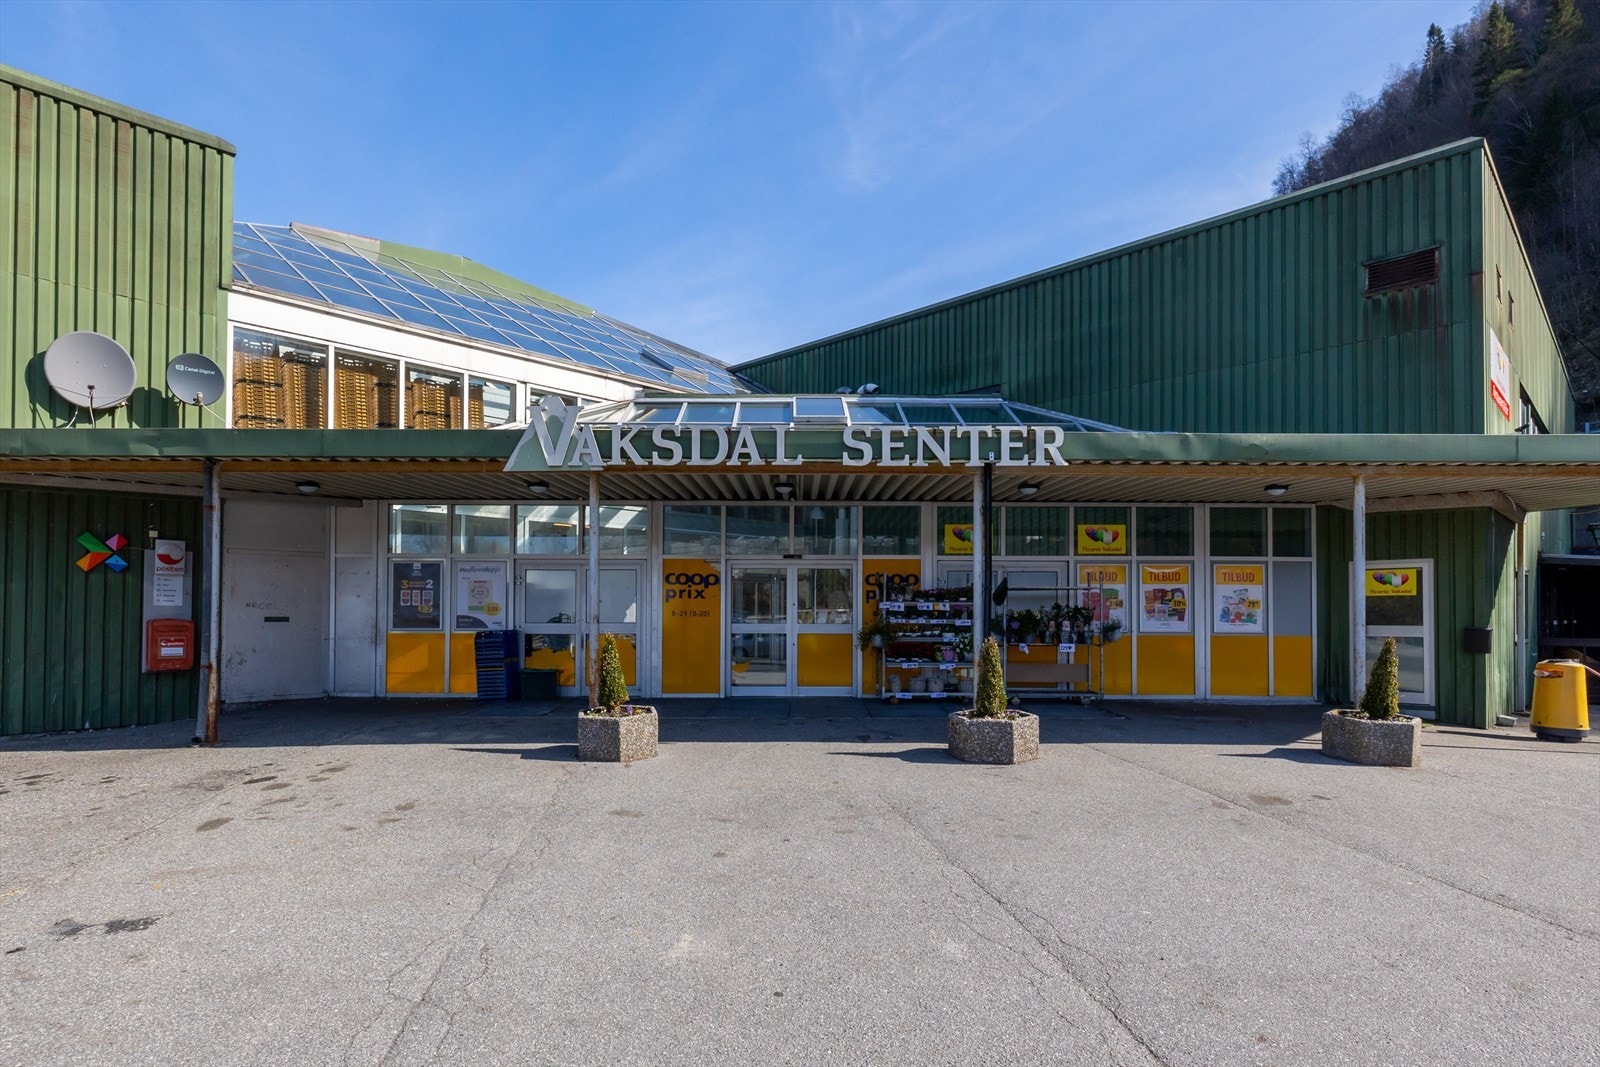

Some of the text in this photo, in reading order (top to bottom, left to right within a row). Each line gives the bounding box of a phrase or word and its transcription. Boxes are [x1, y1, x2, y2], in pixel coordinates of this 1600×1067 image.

[529, 404, 1068, 468] VAKSDAL SENTER
[664, 572, 720, 589] coop
[1085, 571, 1118, 582] ILUD
[1149, 571, 1181, 582] TILBUD
[1222, 571, 1255, 582] TILBUD
[400, 579, 409, 589] 3
[425, 579, 434, 589] 2
[665, 584, 706, 603] prix
